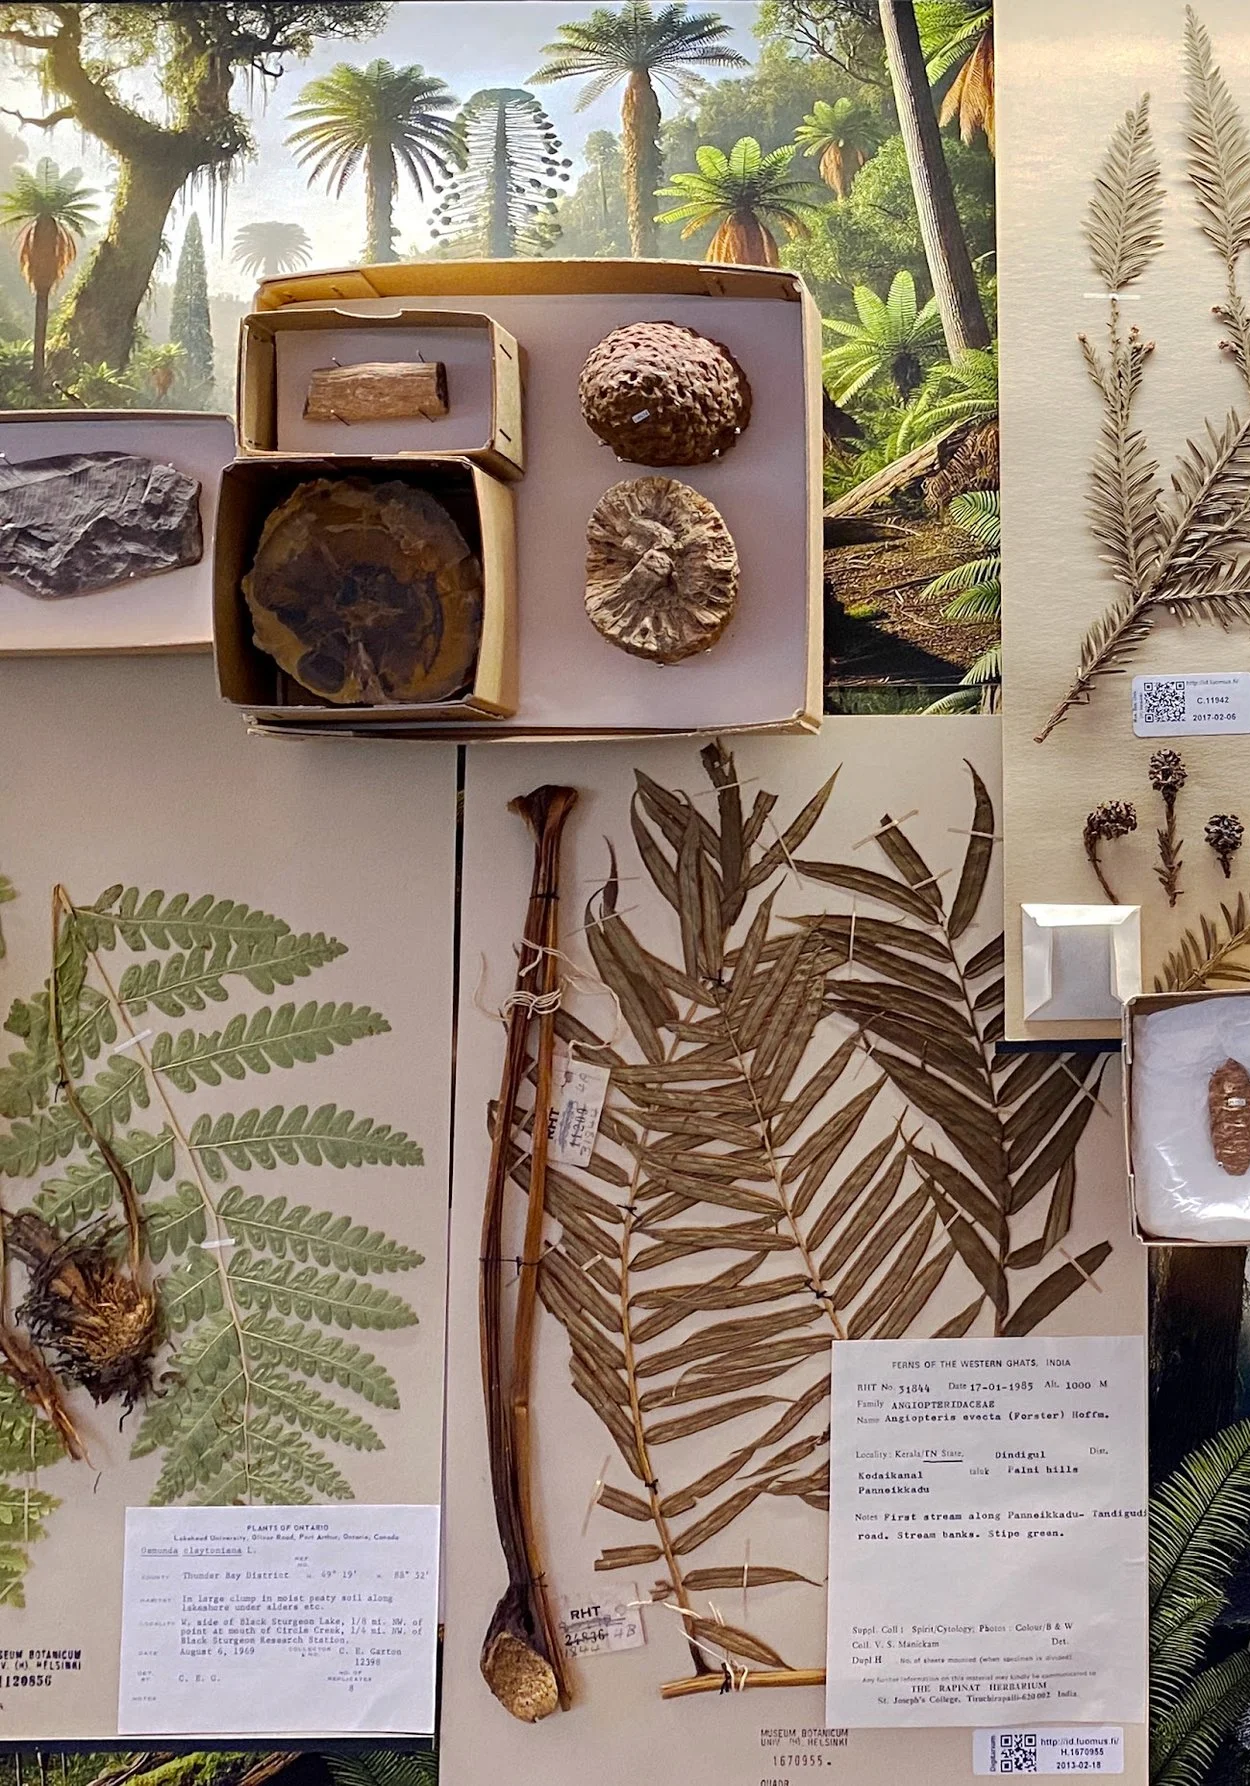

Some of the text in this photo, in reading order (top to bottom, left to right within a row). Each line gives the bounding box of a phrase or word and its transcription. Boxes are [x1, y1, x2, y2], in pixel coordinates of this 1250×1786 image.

[892, 1361, 920, 1369] FERNS
[924, 1361, 936, 1369] OF
[960, 1360, 1002, 1368] WESTERN
[1046, 1359, 1071, 1367] INDIA
[948, 1382, 967, 1390] Date
[970, 1381, 1034, 1392] 17-01-1985
[1065, 1382, 1092, 1390] 1000
[1100, 1380, 1108, 1388] M
[857, 1400, 995, 1410] Family ANGIOPTERIDACEAE
[885, 1414, 956, 1424] Angiopteris
[996, 1451, 1046, 1460] Dindigul
[858, 1471, 924, 1480] Kodaikanal
[1008, 1466, 1040, 1474] Palni
[1046, 1466, 1079, 1474] hills
[855, 1513, 878, 1521] Notes
[884, 1513, 917, 1522] First
[969, 1512, 1001, 1522] along
[858, 1530, 1065, 1540] road. Stream banks. Stipe green.
[571, 1606, 600, 1620] RHT
[29, 1650, 81, 1660] BOTANICUM
[939, 1684, 980, 1692] RAPINAT
[990, 1682, 1047, 1691] HERBARIUM
[761, 1729, 849, 1738] MUSEUM BOTANICUM
[808, 1738, 848, 1747] HELSINKI
[1061, 1748, 1104, 1756] H.1670955
[1057, 1762, 1101, 1770] 2013-02-18
